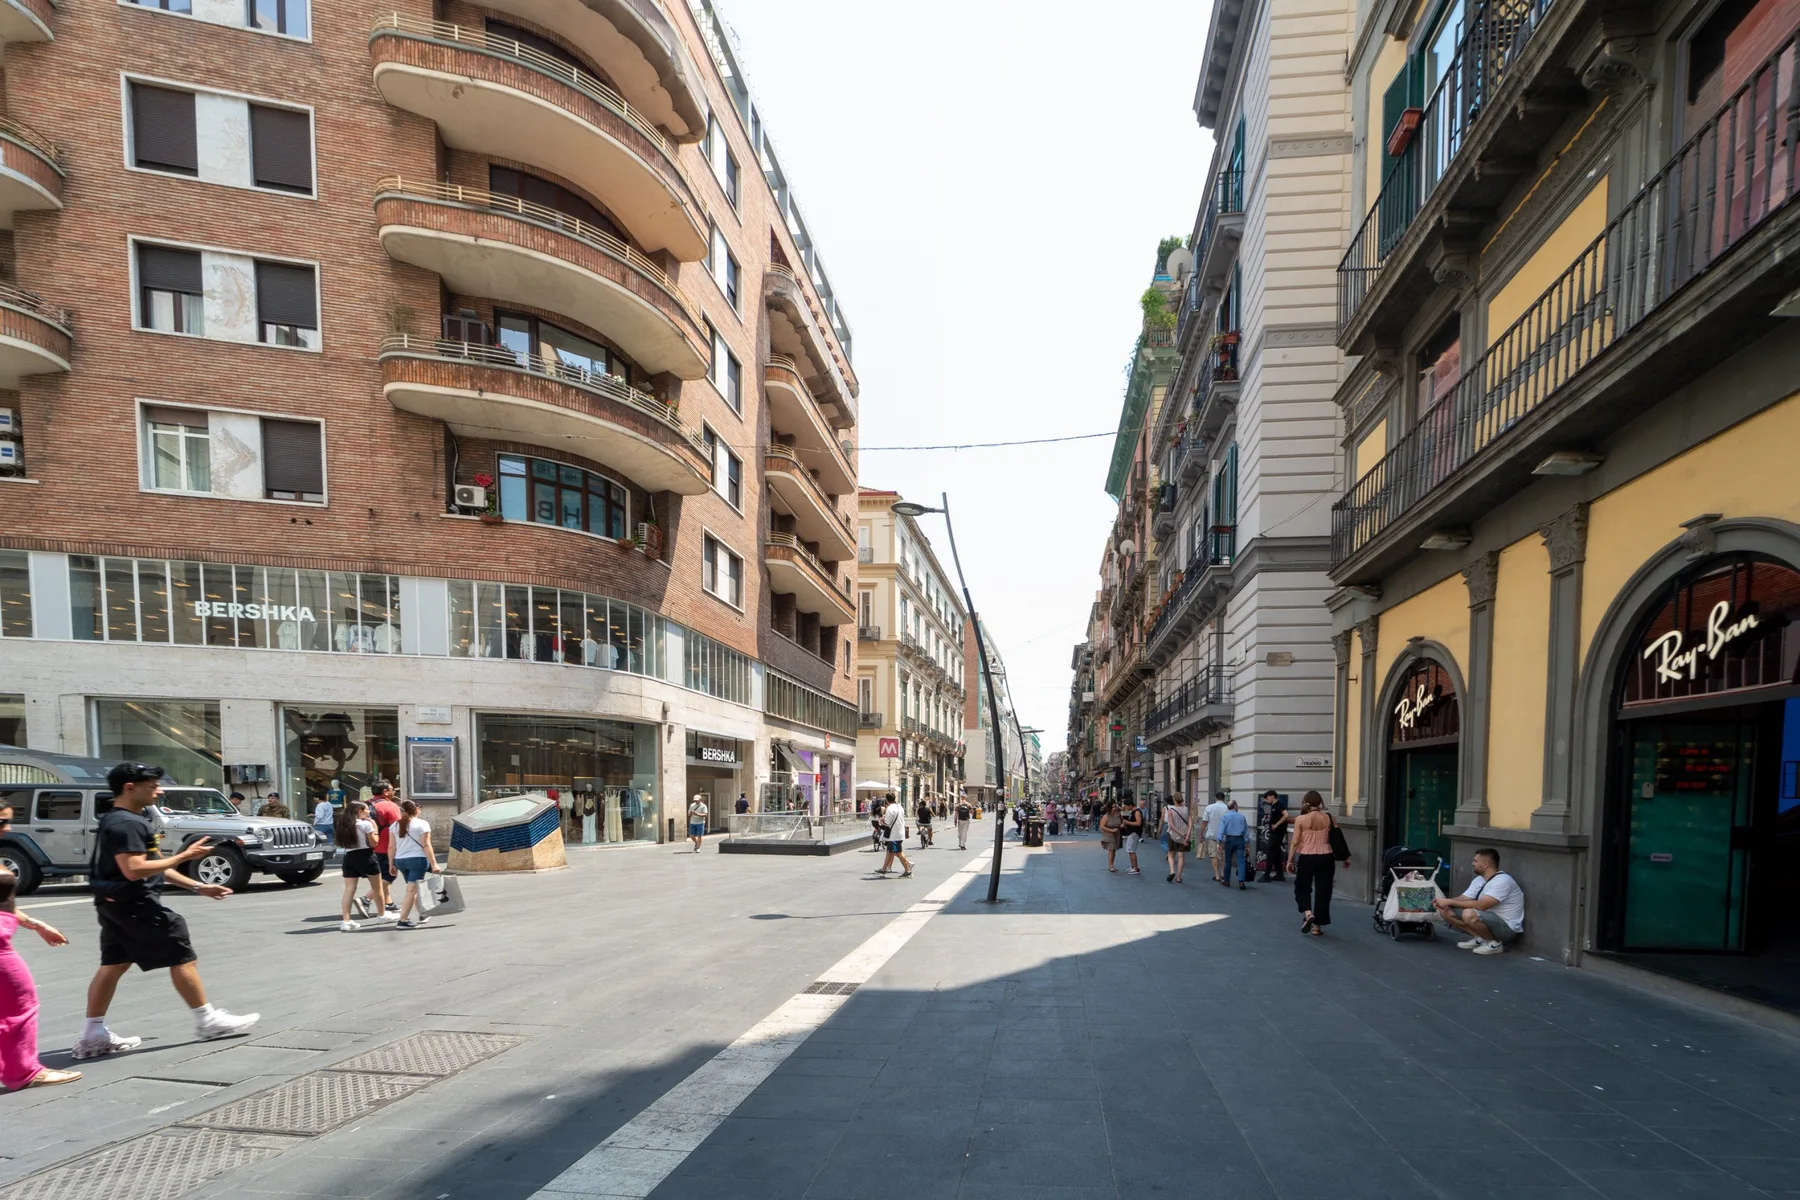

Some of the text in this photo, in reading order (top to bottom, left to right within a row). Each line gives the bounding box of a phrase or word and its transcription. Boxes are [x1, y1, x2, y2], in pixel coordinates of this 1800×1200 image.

[194, 600, 316, 622] BERSHKA
[1643, 600, 1759, 684] Ray-Ban
[1394, 684, 1433, 729] Ray-Ban
[702, 747, 736, 763] BERSHKA
[881, 742, 897, 754] M
